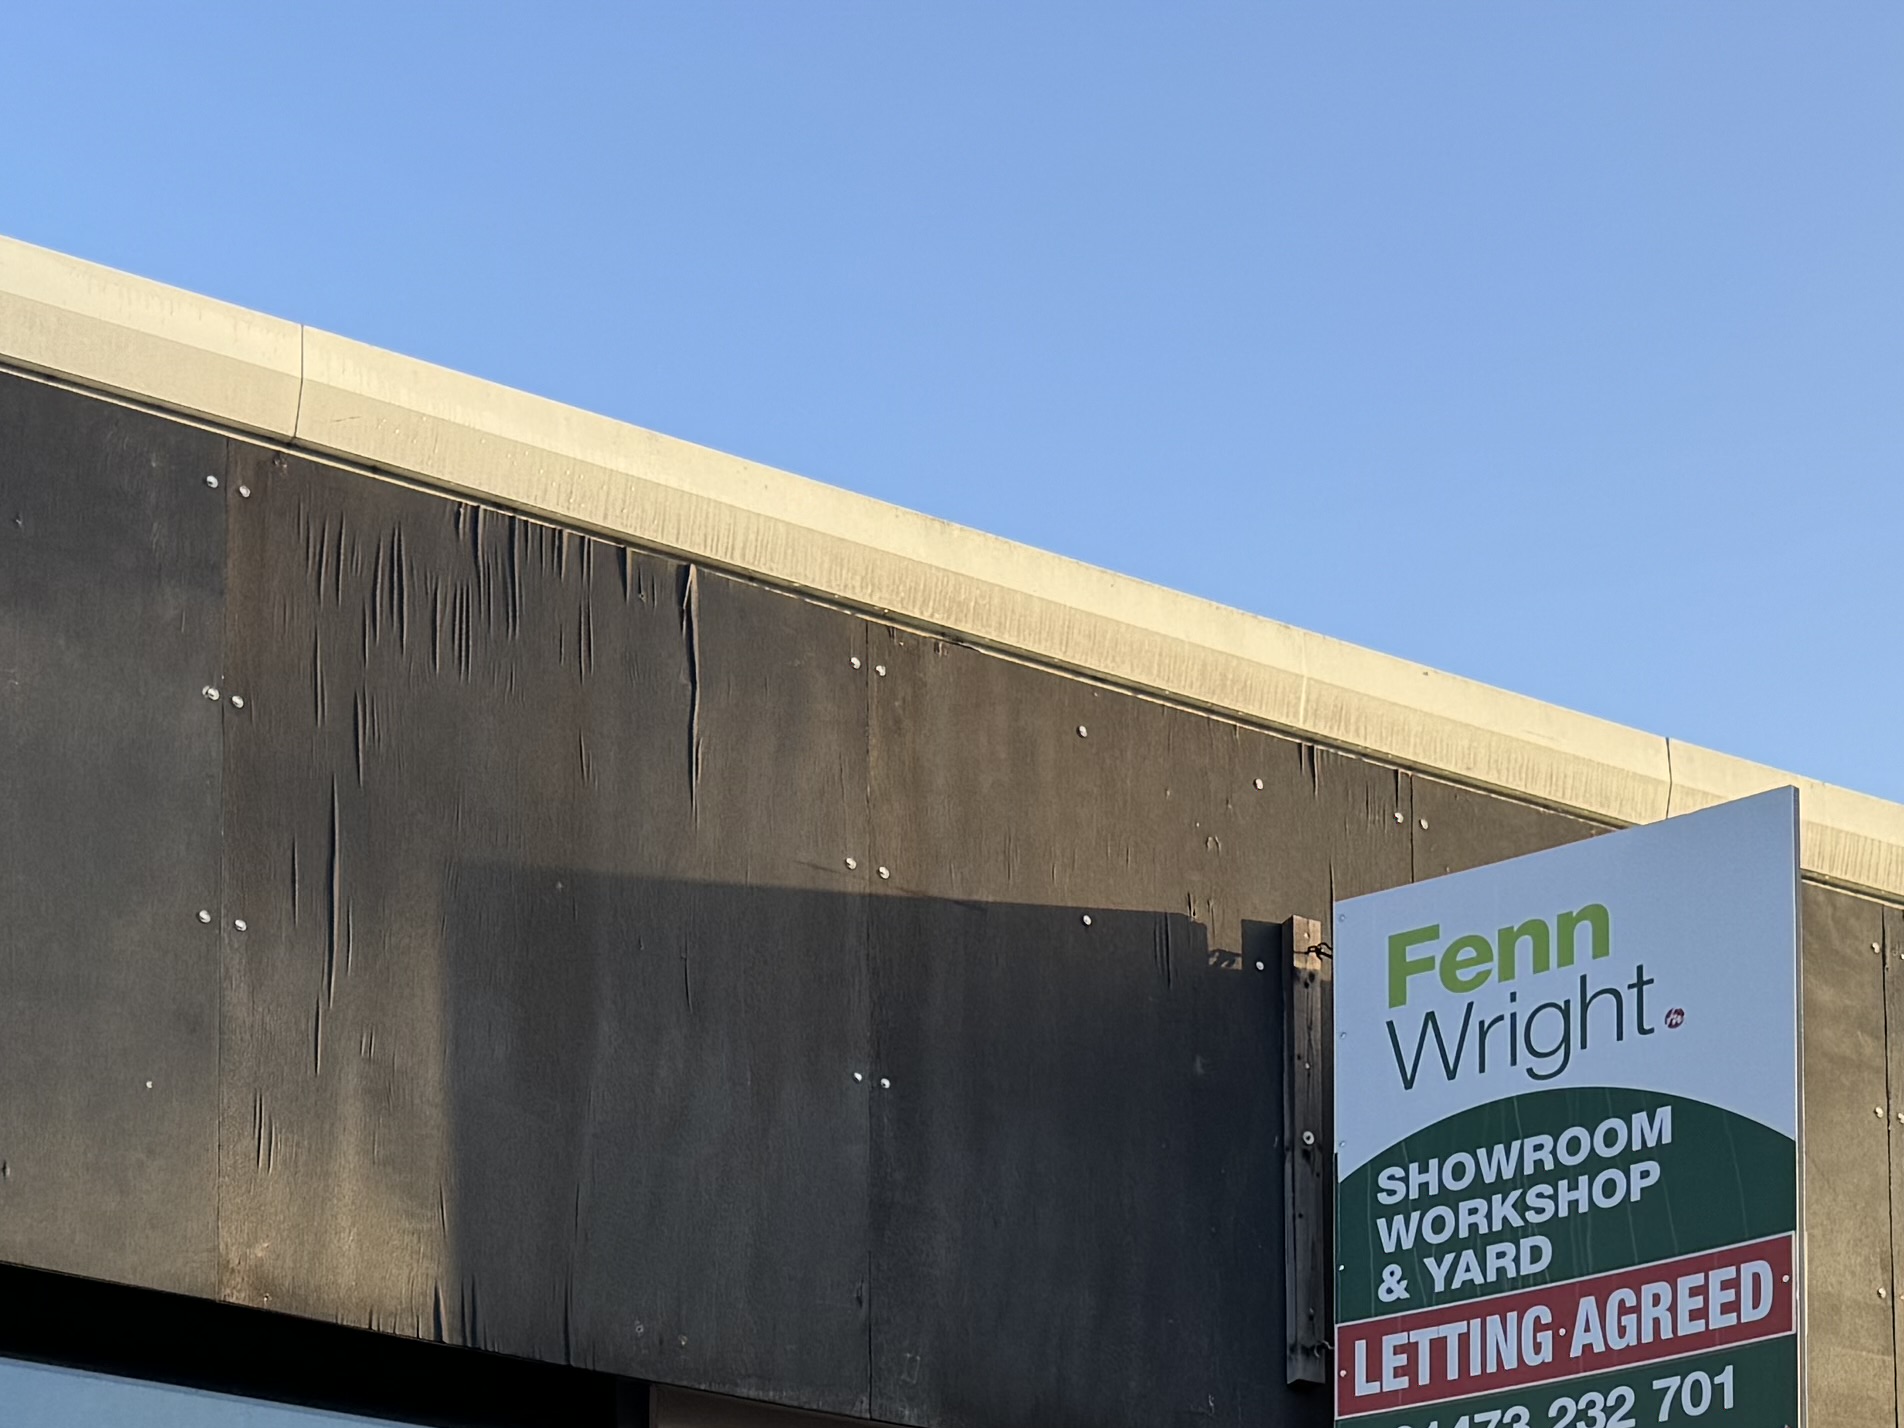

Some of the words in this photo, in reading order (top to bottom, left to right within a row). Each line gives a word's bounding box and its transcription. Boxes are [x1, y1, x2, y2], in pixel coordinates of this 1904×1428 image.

[1388, 902, 1610, 1008] Fenn
[1376, 1106, 1673, 1205] SHOWROOM
[1376, 1160, 1661, 1253] WORKSHOP
[1377, 1263, 1409, 1303] &
[1424, 1235, 1553, 1293] YARD
[1353, 1314, 1553, 1396] LETTING
[1569, 1260, 1774, 1358] AGREED
[1651, 1365, 1735, 1423] 701
